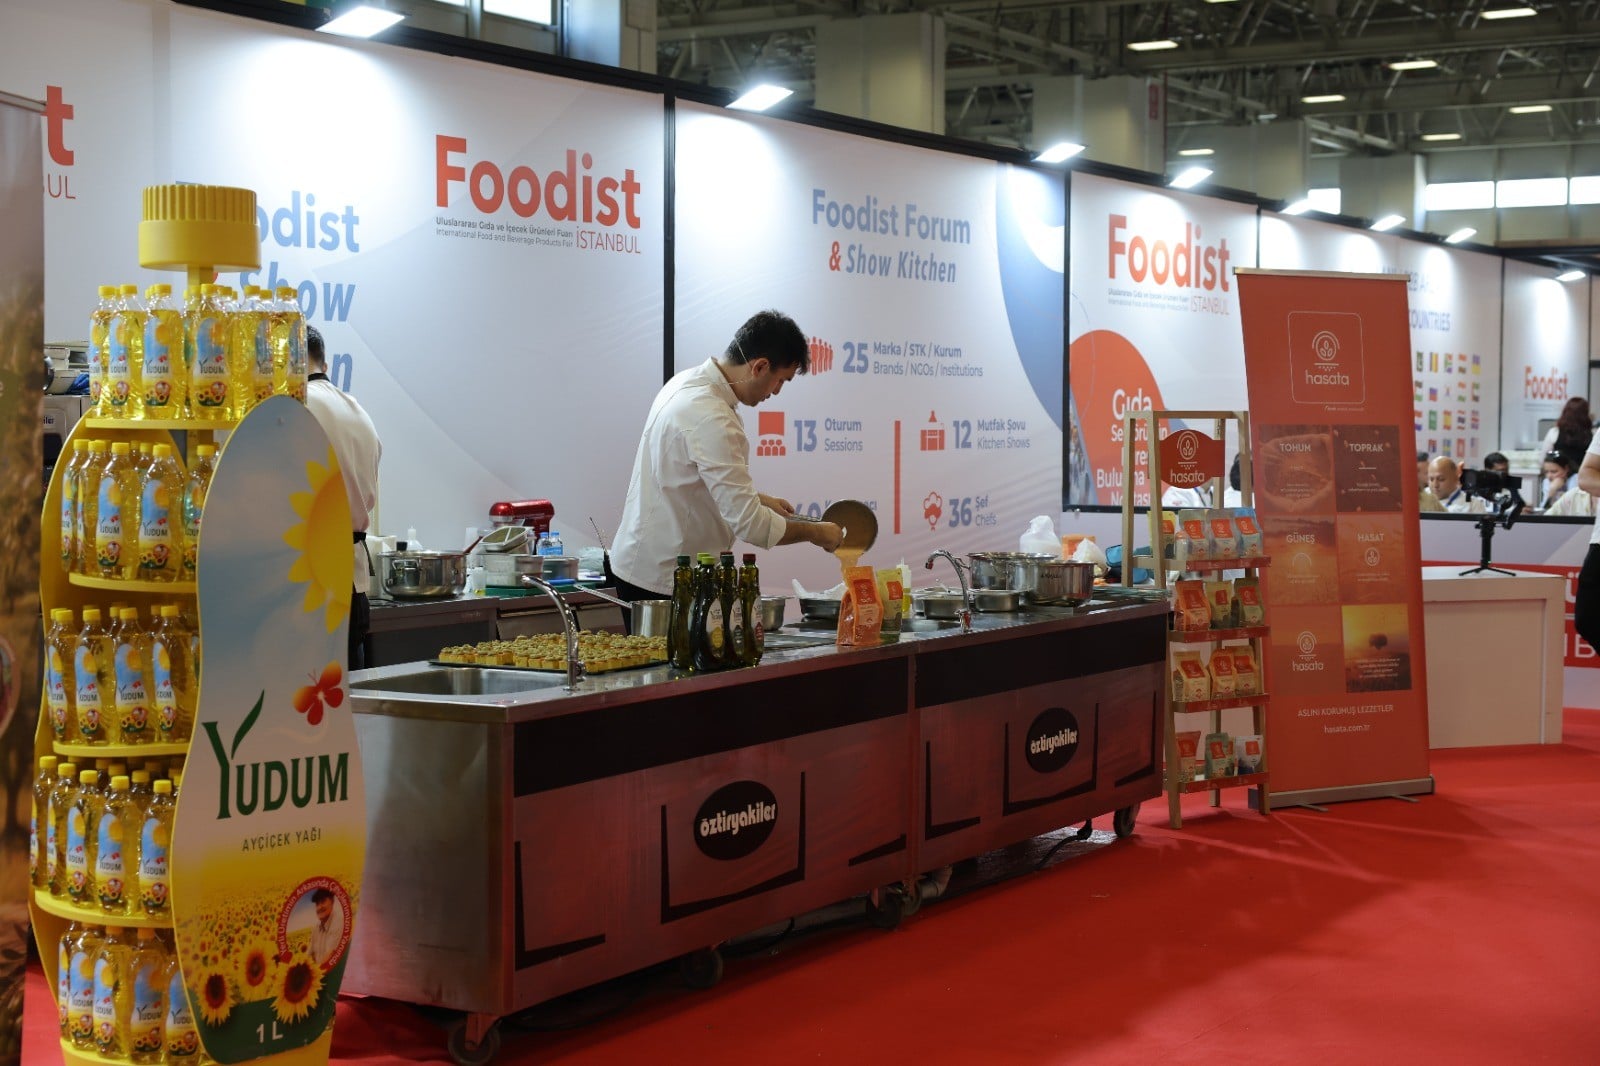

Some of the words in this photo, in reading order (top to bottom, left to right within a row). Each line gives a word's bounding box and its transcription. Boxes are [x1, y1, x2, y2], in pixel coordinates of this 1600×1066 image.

[436, 135, 640, 229] Foodist
[436, 216, 477, 229] Uluslararası
[479, 221, 495, 231] Gıda
[505, 223, 528, 234] İçecek
[529, 225, 555, 236] Ürünleri
[812, 189, 899, 236] Foodist
[905, 204, 970, 244] Forum
[436, 228, 477, 239] International
[477, 232, 493, 241] Food
[494, 234, 506, 242] and
[507, 234, 534, 246] Beverage
[535, 237, 561, 247] Products
[562, 239, 573, 248] Fair
[576, 226, 641, 254] İSTANBUL
[829, 241, 841, 271] &
[846, 244, 892, 277] Show
[897, 251, 957, 283] Kitchen
[1109, 214, 1230, 292] Foodist
[1410, 309, 1450, 331] OUNTRIES
[842, 341, 869, 373] 25
[874, 341, 902, 356] Marka
[909, 343, 926, 357] STK
[934, 344, 962, 358] Kurum
[874, 361, 903, 376] Brands
[910, 363, 934, 377] NGOs
[940, 363, 983, 377] Institutions
[1305, 369, 1350, 386] hasata
[1524, 366, 1568, 400] Foodist
[825, 417, 862, 432] Oturum
[952, 420, 972, 449] 12
[977, 418, 1005, 432] Mutfak
[1006, 419, 1027, 434] Şovu
[794, 420, 817, 452] 13
[824, 438, 863, 453] Sessions
[977, 436, 1006, 449] Kitchen
[1007, 438, 1031, 450] Shows
[1279, 442, 1312, 452] TOHUM
[1349, 442, 1384, 452] TOPRAK
[1170, 470, 1205, 484] hasata
[949, 497, 972, 528] 36
[975, 495, 989, 511] Şef
[975, 512, 997, 527] Chefs
[1286, 531, 1315, 545] GÜNEŞ
[1357, 533, 1385, 542] HASAT
[1292, 661, 1324, 672] hasata
[119, 684, 144, 701] YUDUM
[1357, 704, 1394, 714] LEZZETLER
[1030, 728, 1077, 754] öztiryakiler
[202, 689, 349, 820] YUDUM
[700, 801, 776, 837] öztiryakiler
[242, 831, 290, 852] AYÇİÇEK
[296, 827, 321, 844] YAĞI
[256, 1023, 264, 1043] 1
[272, 1020, 283, 1040] L
